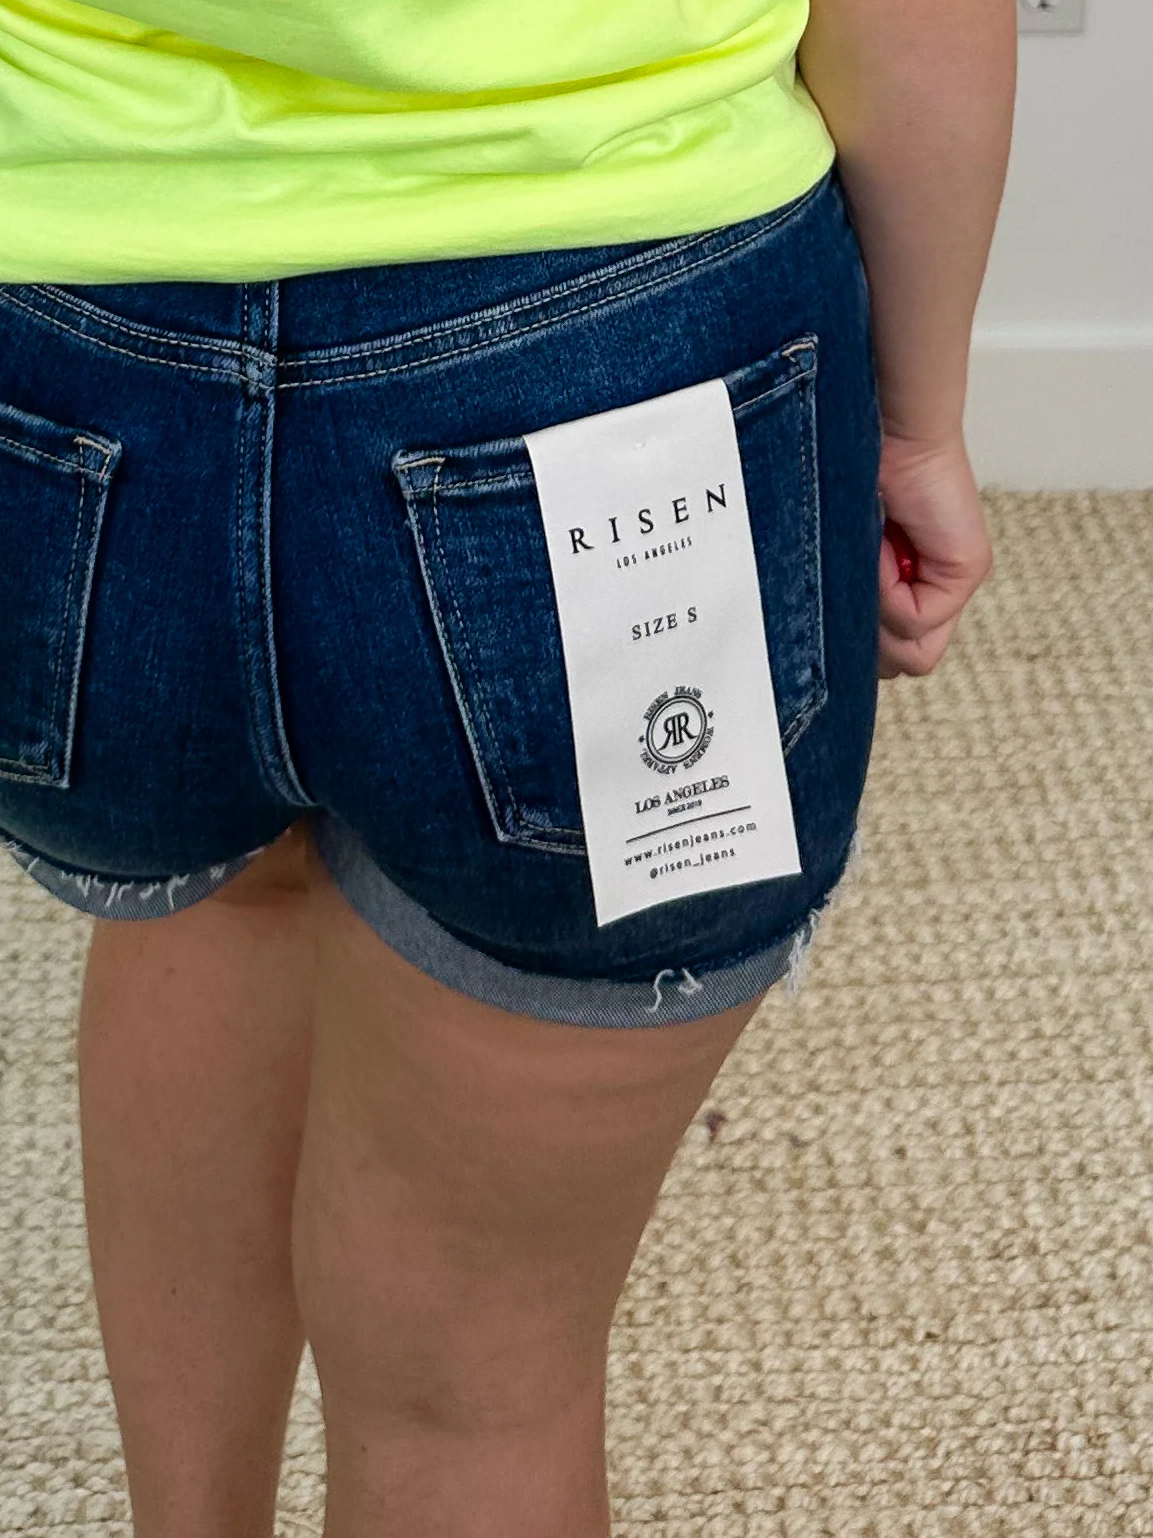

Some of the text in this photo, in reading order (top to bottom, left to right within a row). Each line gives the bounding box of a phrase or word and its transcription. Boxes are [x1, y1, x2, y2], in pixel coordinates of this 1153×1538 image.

[568, 483, 728, 554] RISEN
[616, 536, 693, 569] LOS ANGELES
[631, 606, 698, 641] SIZE S
[635, 775, 730, 814] LOS ANGELES
[624, 822, 757, 866] www.risenjeans.com
[649, 848, 735, 879] @risen_jeans
